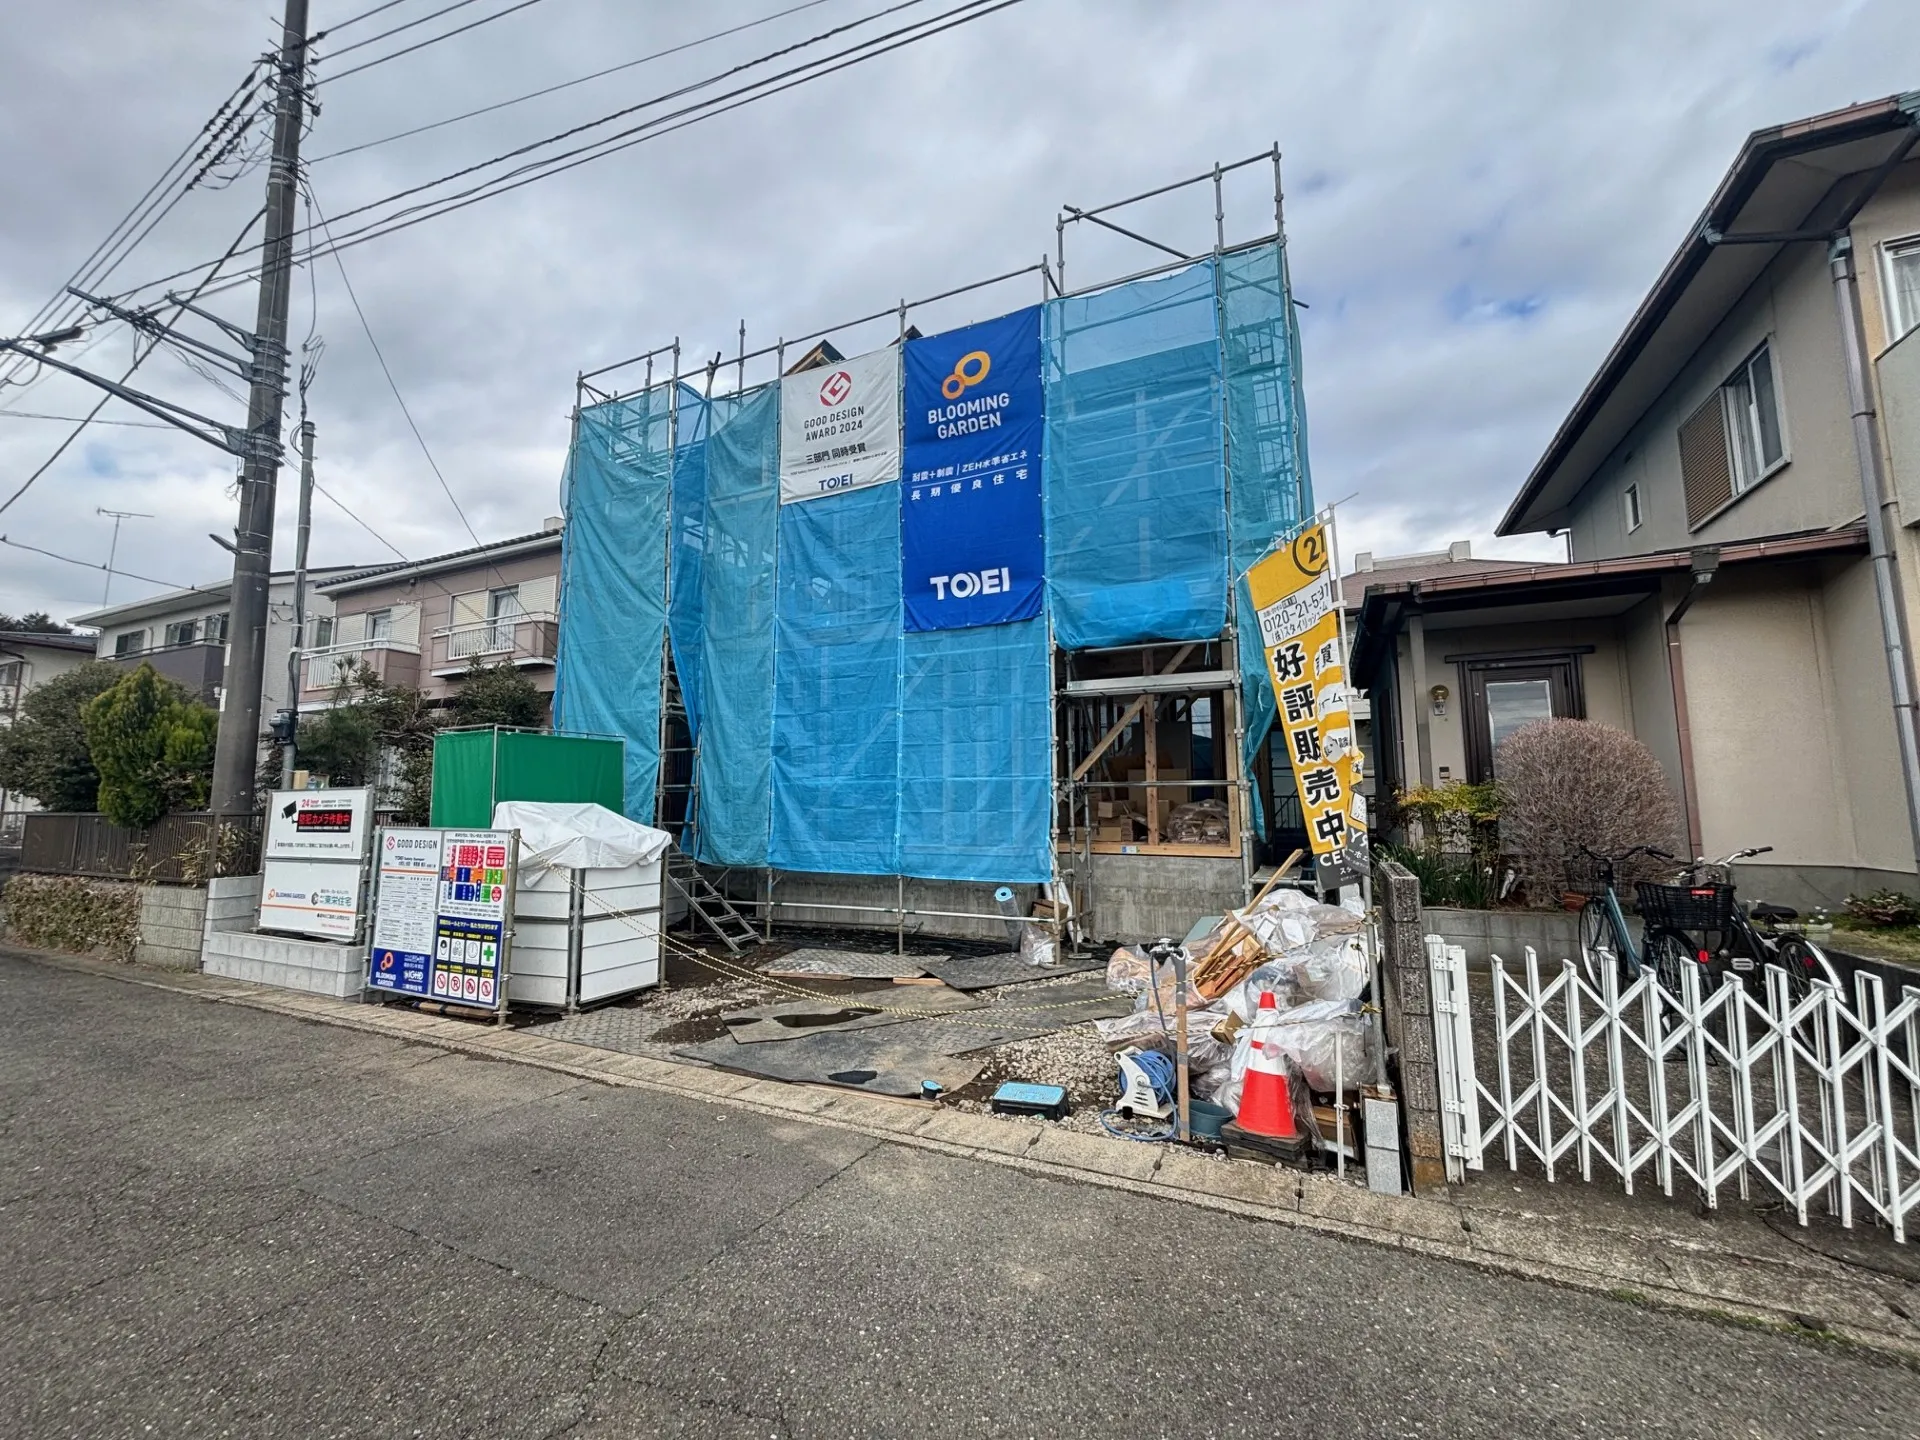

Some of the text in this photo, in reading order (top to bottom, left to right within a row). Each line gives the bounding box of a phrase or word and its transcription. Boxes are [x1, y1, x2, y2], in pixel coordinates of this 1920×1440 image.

[804, 406, 865, 429] GOOD DESIGN
[928, 393, 1009, 424] BLOOMING
[805, 420, 863, 442] AWARD 2024
[937, 412, 1002, 439] GARDEN
[805, 451, 831, 465] 三部門
[831, 442, 867, 459] 同時受賞
[818, 473, 853, 491] TOEI
[911, 468, 1028, 501] 長期優良住宅
[929, 567, 1011, 600] TOEI
[1273, 642, 1346, 847] 好評販売中
[396, 839, 414, 849] GOOD
[414, 839, 438, 849] DESIGN
